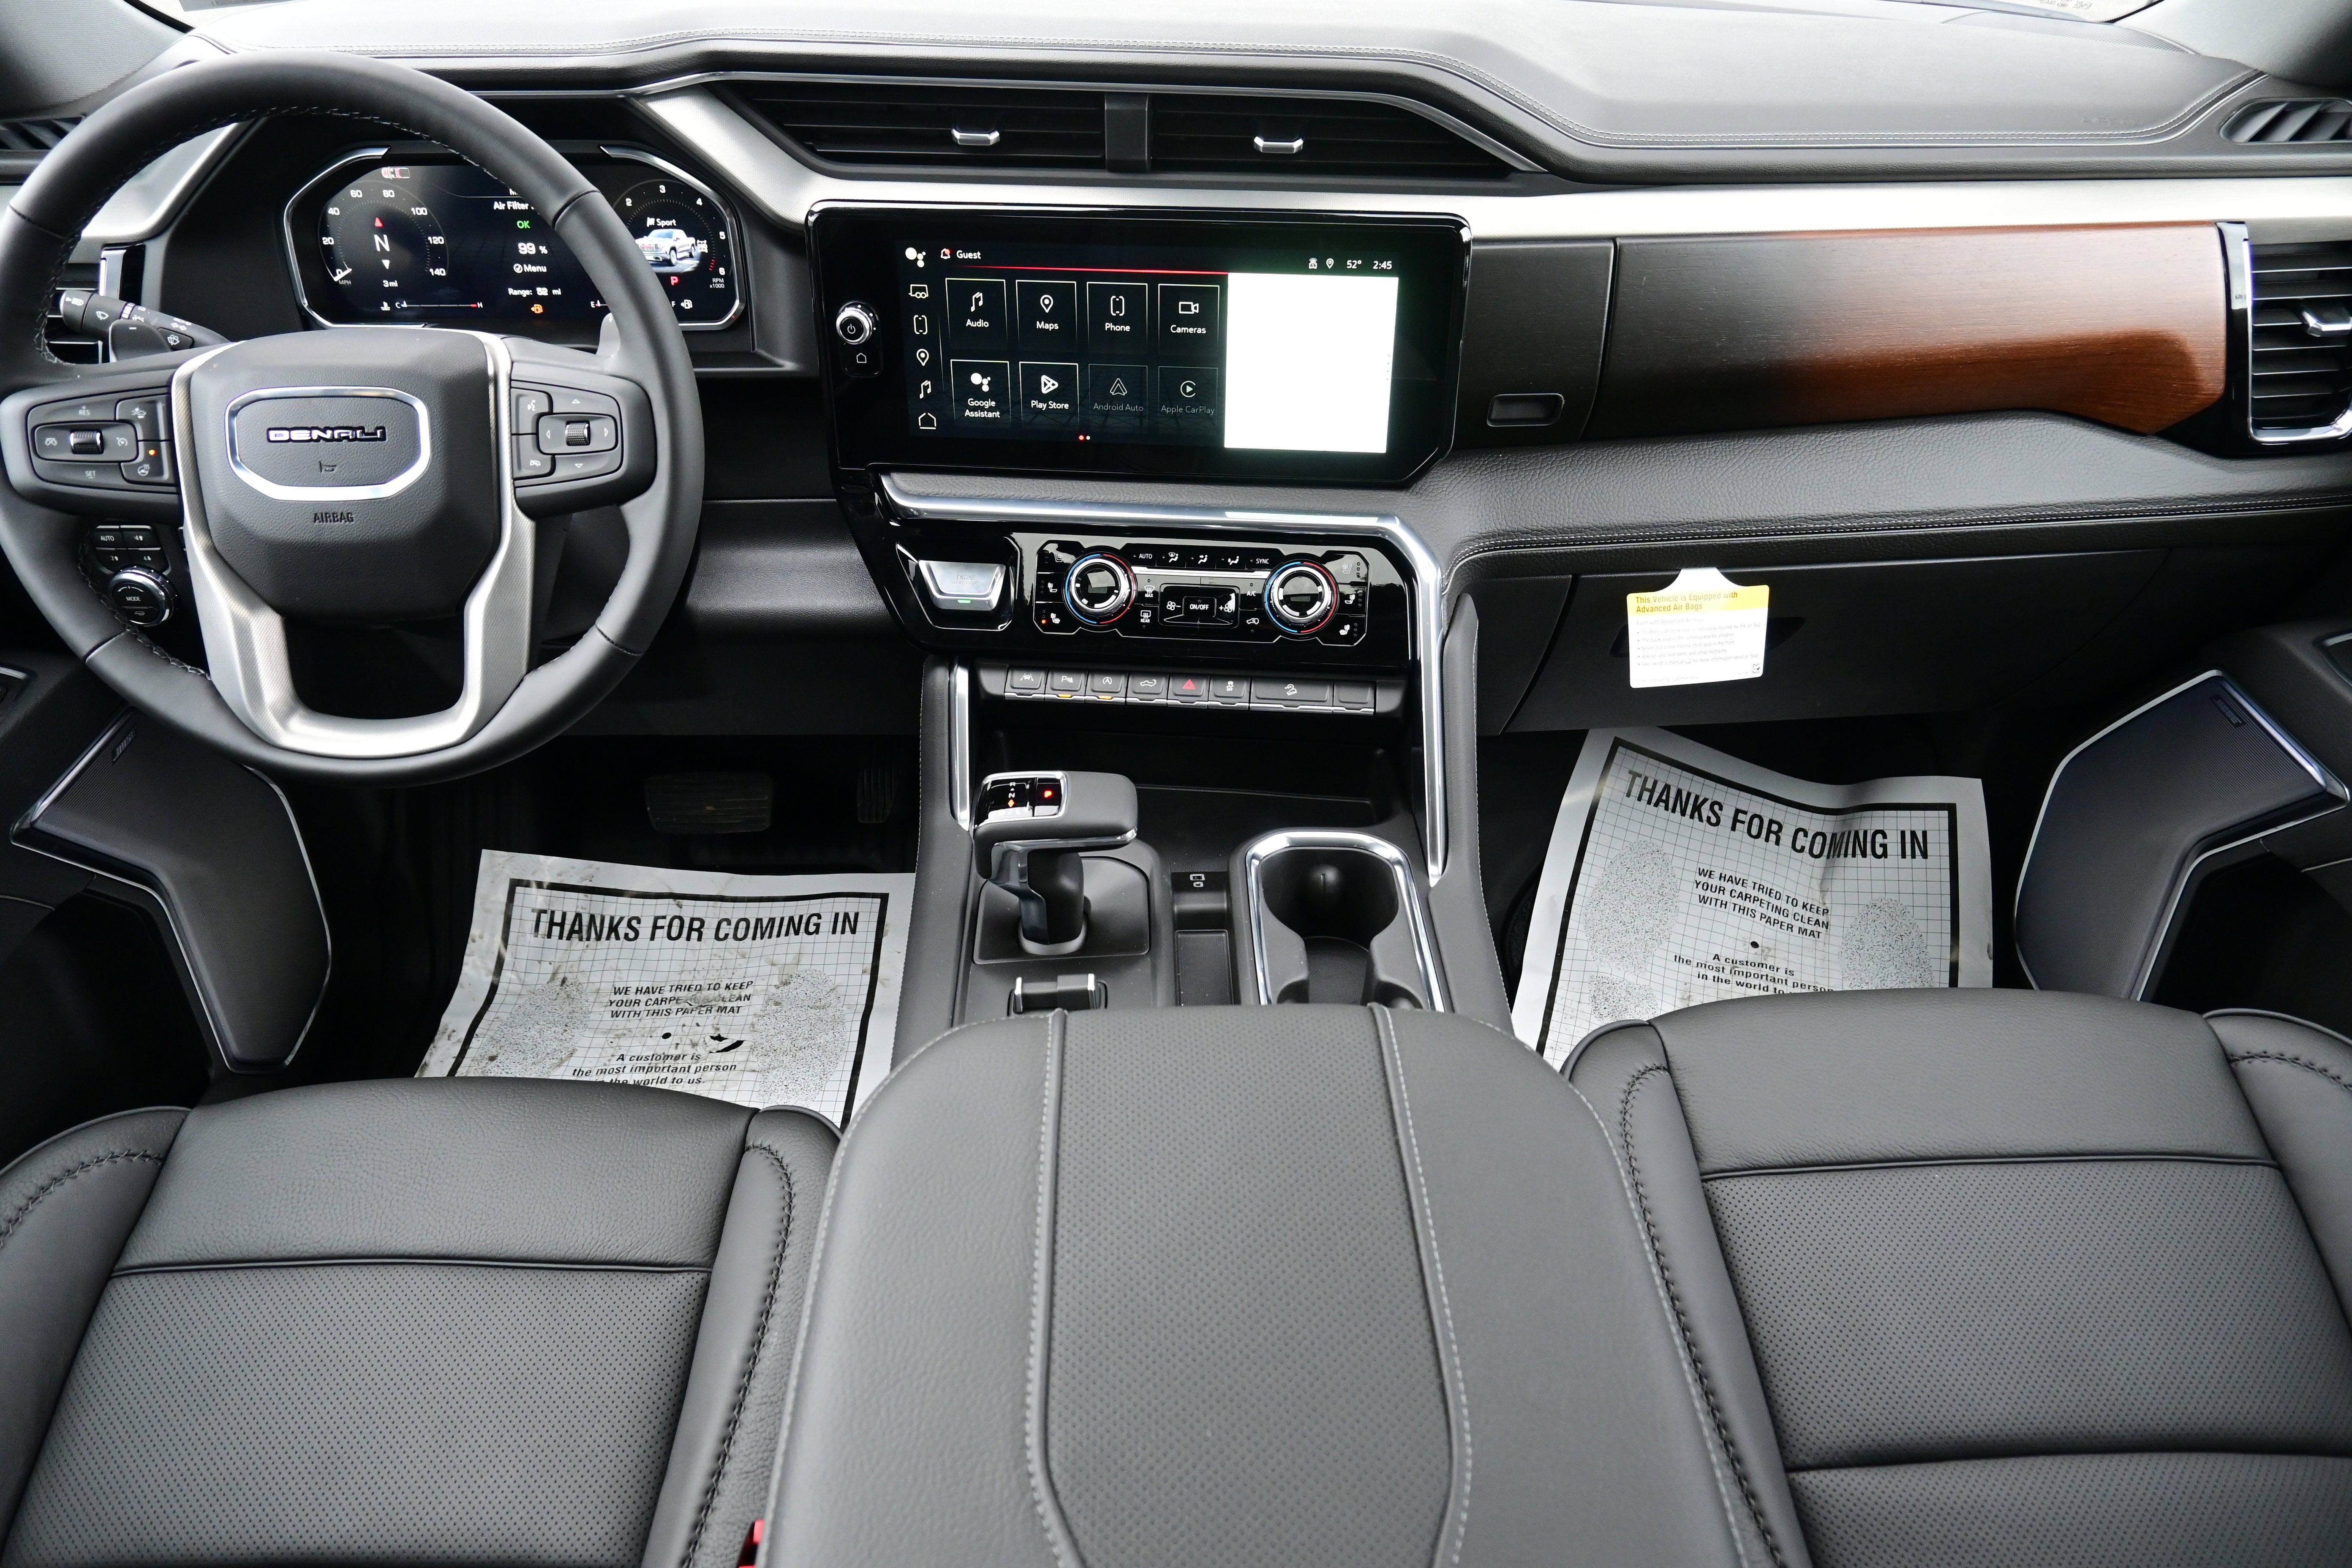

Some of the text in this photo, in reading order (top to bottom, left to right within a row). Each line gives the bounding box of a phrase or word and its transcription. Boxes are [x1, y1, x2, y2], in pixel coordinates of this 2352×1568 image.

[659, 185, 666, 193] 3
[383, 190, 395, 198] 80
[493, 201, 506, 210] Air
[506, 201, 529, 210] Filter
[626, 198, 632, 206] 2
[328, 207, 340, 215] 40
[411, 207, 427, 216] 100
[517, 220, 531, 229] OK
[656, 218, 676, 227] Sport
[719, 231, 726, 240] 5
[322, 237, 334, 245] 20
[374, 234, 390, 252] N
[427, 236, 444, 245] 120
[518, 242, 536, 254] 99
[956, 250, 981, 259] Guest
[523, 264, 547, 272] Menu
[1373, 261, 1392, 270] 2:45
[429, 268, 446, 276] 140
[719, 267, 725, 275] 6
[670, 276, 678, 286] P
[508, 288, 533, 297] Range:
[966, 319, 989, 327] Audio
[1036, 321, 1059, 331] Maps
[1105, 323, 1130, 332] Phone
[1170, 324, 1206, 334] Cameras
[968, 398, 996, 408] Google
[1031, 400, 1069, 410] Play Store
[1093, 403, 1143, 411] Android Auto
[964, 409, 1000, 418] Assistant
[1161, 405, 1215, 416] Apple CarPlay
[268, 429, 384, 441] DENALI
[313, 512, 354, 523] AIRBAG
[1652, 595, 1678, 603] Vehicle
[1689, 593, 1720, 602] Equipped
[1636, 604, 1671, 612] Advanced
[1685, 603, 1702, 611] Bags
[1626, 770, 1928, 859] THANKS FOR COMING IN
[1698, 867, 1829, 917] WE HAVE TRIED TO KEEP
[1695, 879, 1829, 930] YOUR CARPETING CLEAN
[1699, 894, 1822, 939] WITH THIS PAPER MAT
[531, 908, 859, 942] THANKS FOR COMING IN
[1712, 953, 1795, 977] A customer is
[1674, 954, 1834, 993] the most important person
[1697, 971, 1708, 980] in
[1712, 975, 1731, 985] the
[1735, 980, 1769, 992] world
[613, 981, 753, 995] WE HAVE TRIED TO KEEP
[609, 999, 641, 1007] YOUR
[610, 1006, 743, 1018] WITH THIS PAPER MAT
[629, 1053, 686, 1062] customer
[690, 1053, 701, 1061] is
[572, 1064, 737, 1077] the most important person
[633, 1076, 667, 1086] world
